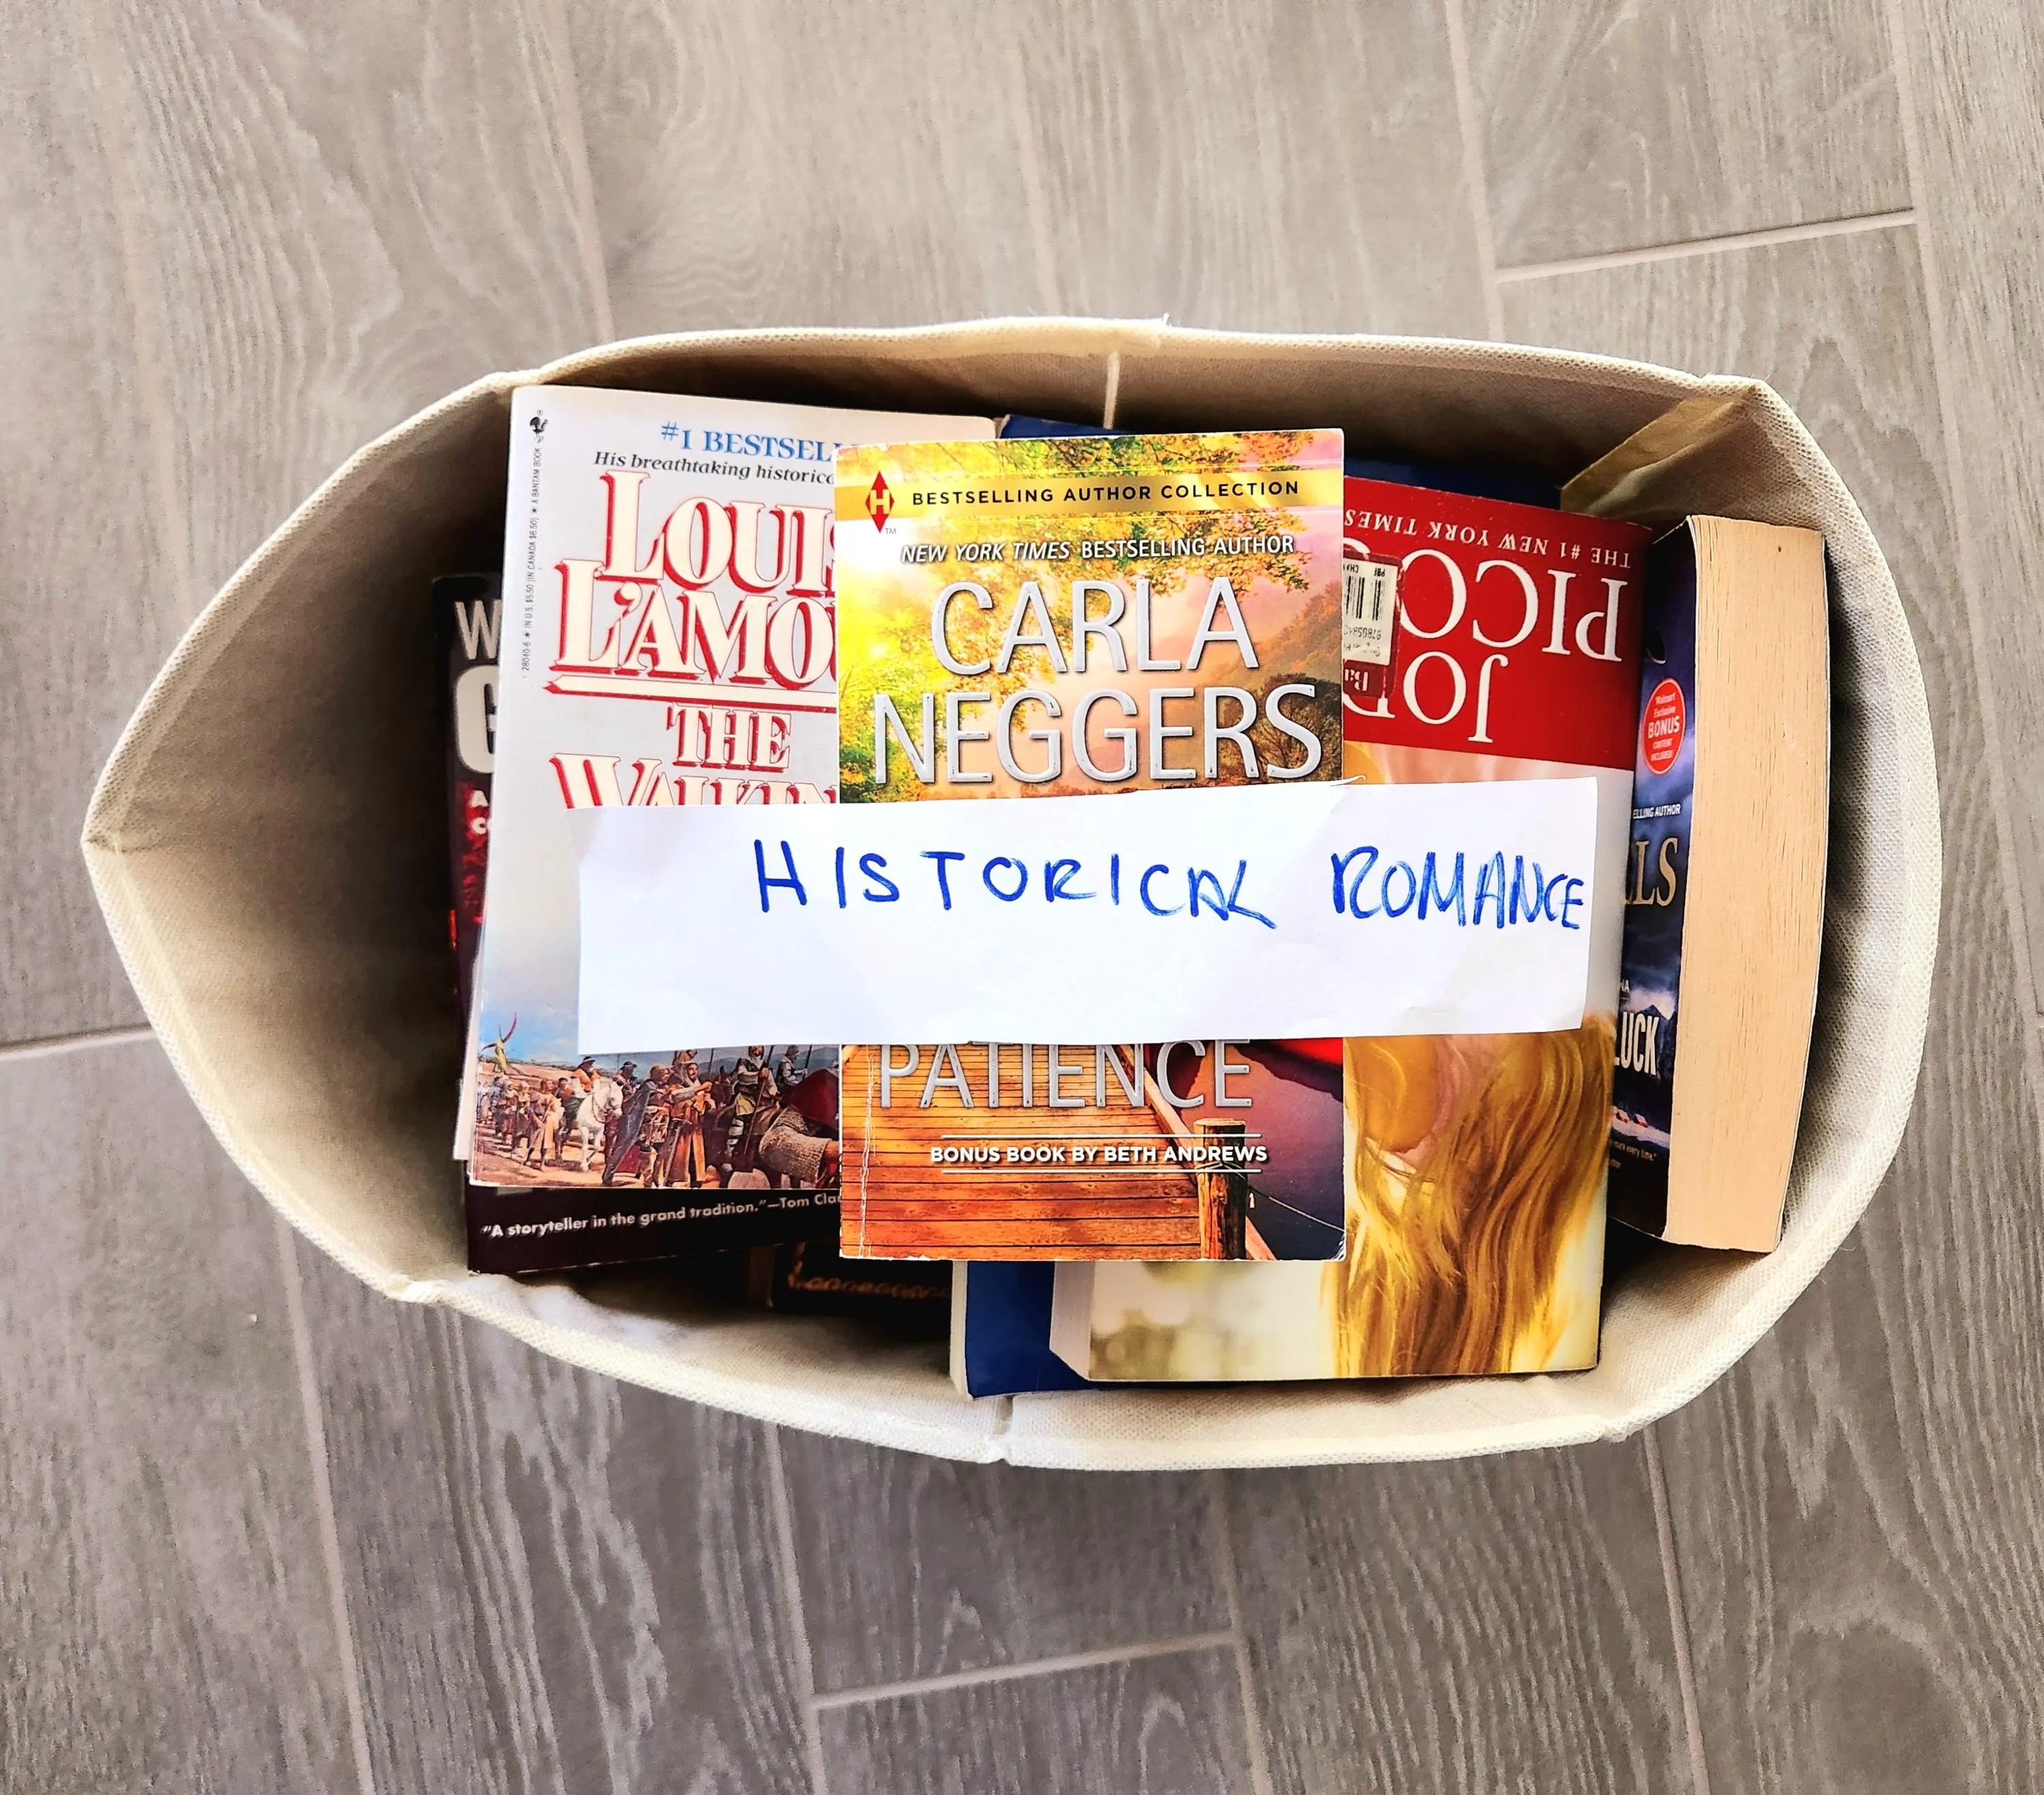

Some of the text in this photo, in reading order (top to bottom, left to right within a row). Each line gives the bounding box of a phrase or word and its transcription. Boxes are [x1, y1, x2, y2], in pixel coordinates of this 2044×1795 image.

[533, 447, 542, 466] BOOK
[594, 451, 626, 467] His
[631, 453, 751, 480] breathtaking
[661, 422, 845, 462] #1 BESTSEL
[531, 470, 540, 497] BANTAM
[913, 481, 1299, 506] BESTSELLING AUTHOR COLLECTION
[527, 542, 537, 570] CANADA
[600, 470, 835, 598] LOUI
[901, 534, 1295, 563] NEW YORK TIMES BESTSELLING AUTHOR
[1344, 510, 1630, 568] THE #1 NEW YORK TIMES
[549, 558, 836, 690] L'AMO
[1344, 537, 1628, 662] PICO
[931, 576, 1259, 675] CARLA
[667, 702, 792, 773] THE
[873, 683, 1324, 784] NEGGERS
[1647, 716, 1681, 739] BONUS
[1654, 803, 1682, 817] AUTHOR
[754, 839, 1585, 930] HISTORICAL ROMANCE
[1625, 838, 1678, 906] LS
[1614, 1011, 1660, 1075] UCK
[880, 1039, 1253, 1109] PATIENCE
[931, 1145, 1268, 1163] BONUS BOOK BY BETH ANDREWS
[508, 1216, 589, 1238] storyteller
[592, 1214, 607, 1228] in
[610, 1212, 636, 1225] the
[639, 1206, 686, 1226] grand
